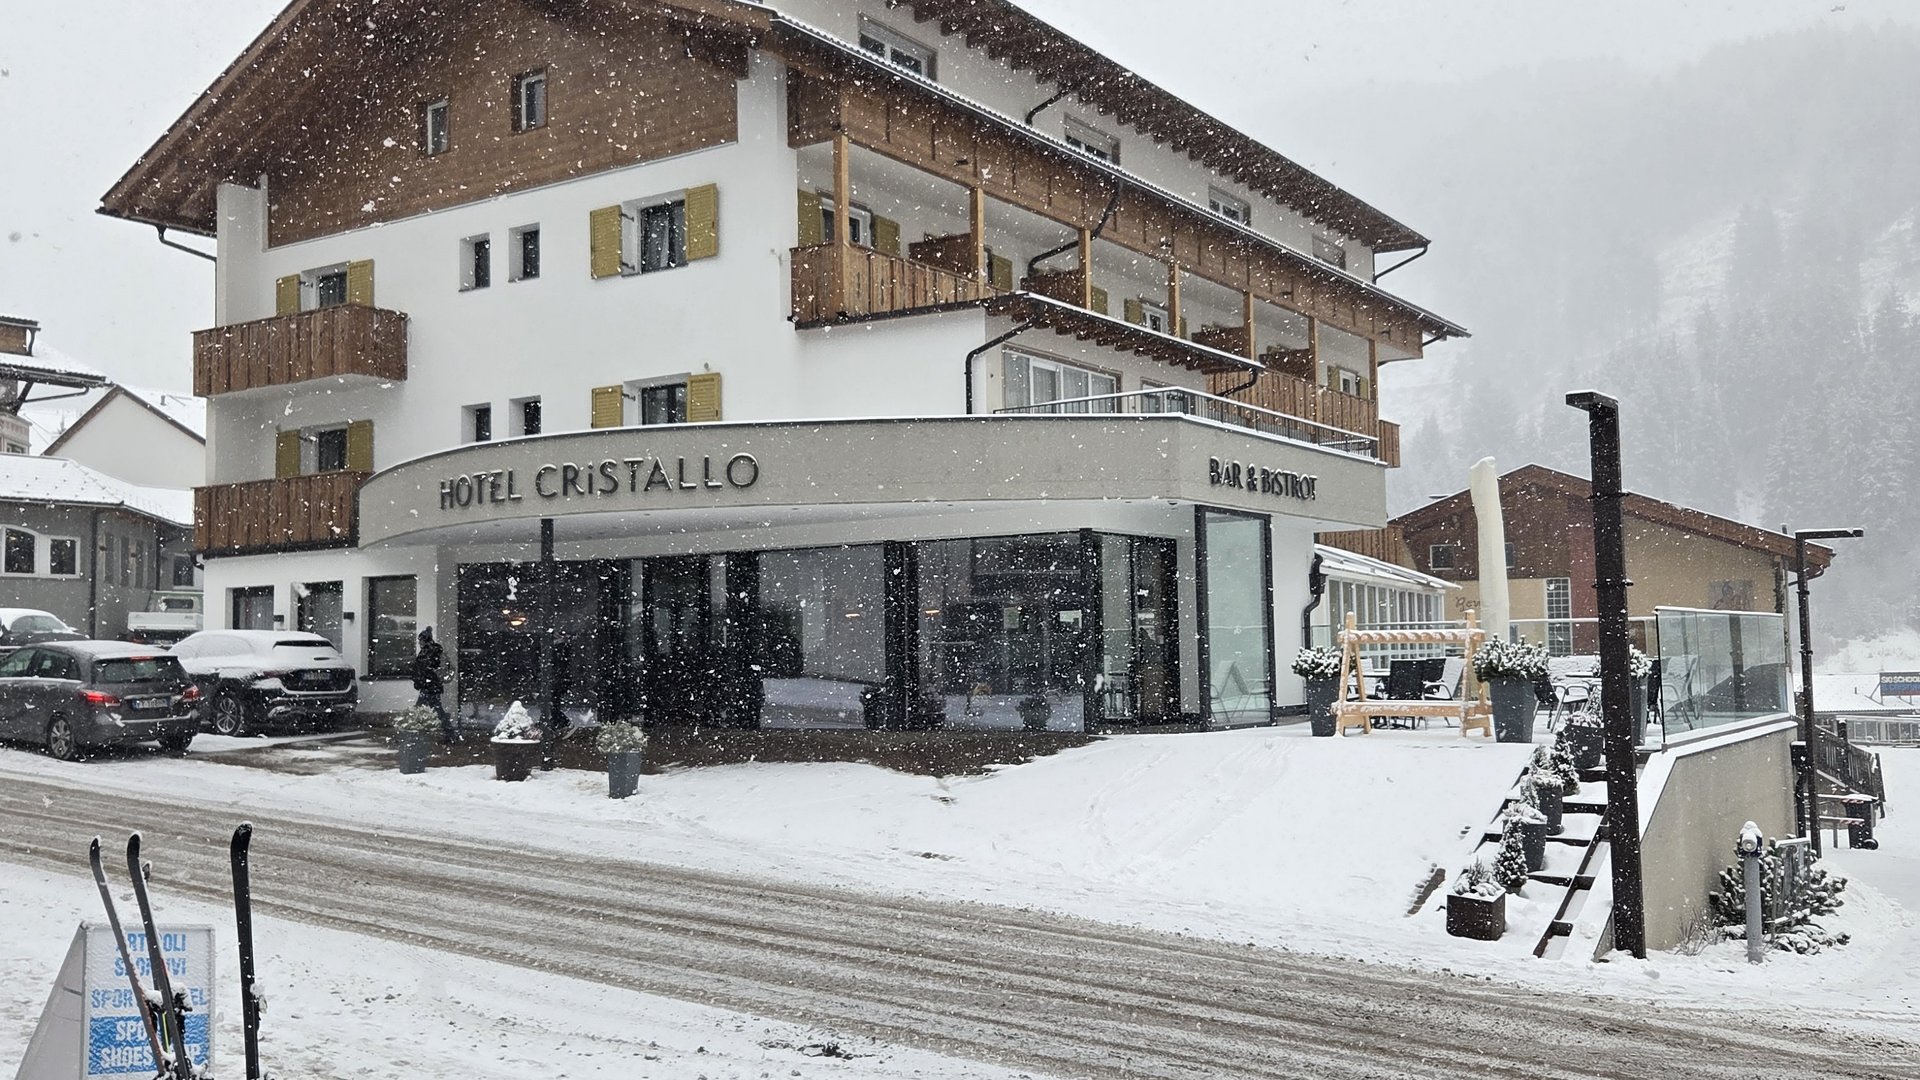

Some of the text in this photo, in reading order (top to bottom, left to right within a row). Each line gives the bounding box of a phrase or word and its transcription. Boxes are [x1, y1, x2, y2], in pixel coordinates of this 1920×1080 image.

[440, 468, 522, 510] HOTEL
[1210, 456, 1243, 489] BAR
[1247, 463, 1257, 492] &
[116, 933, 186, 952] RTOLI
